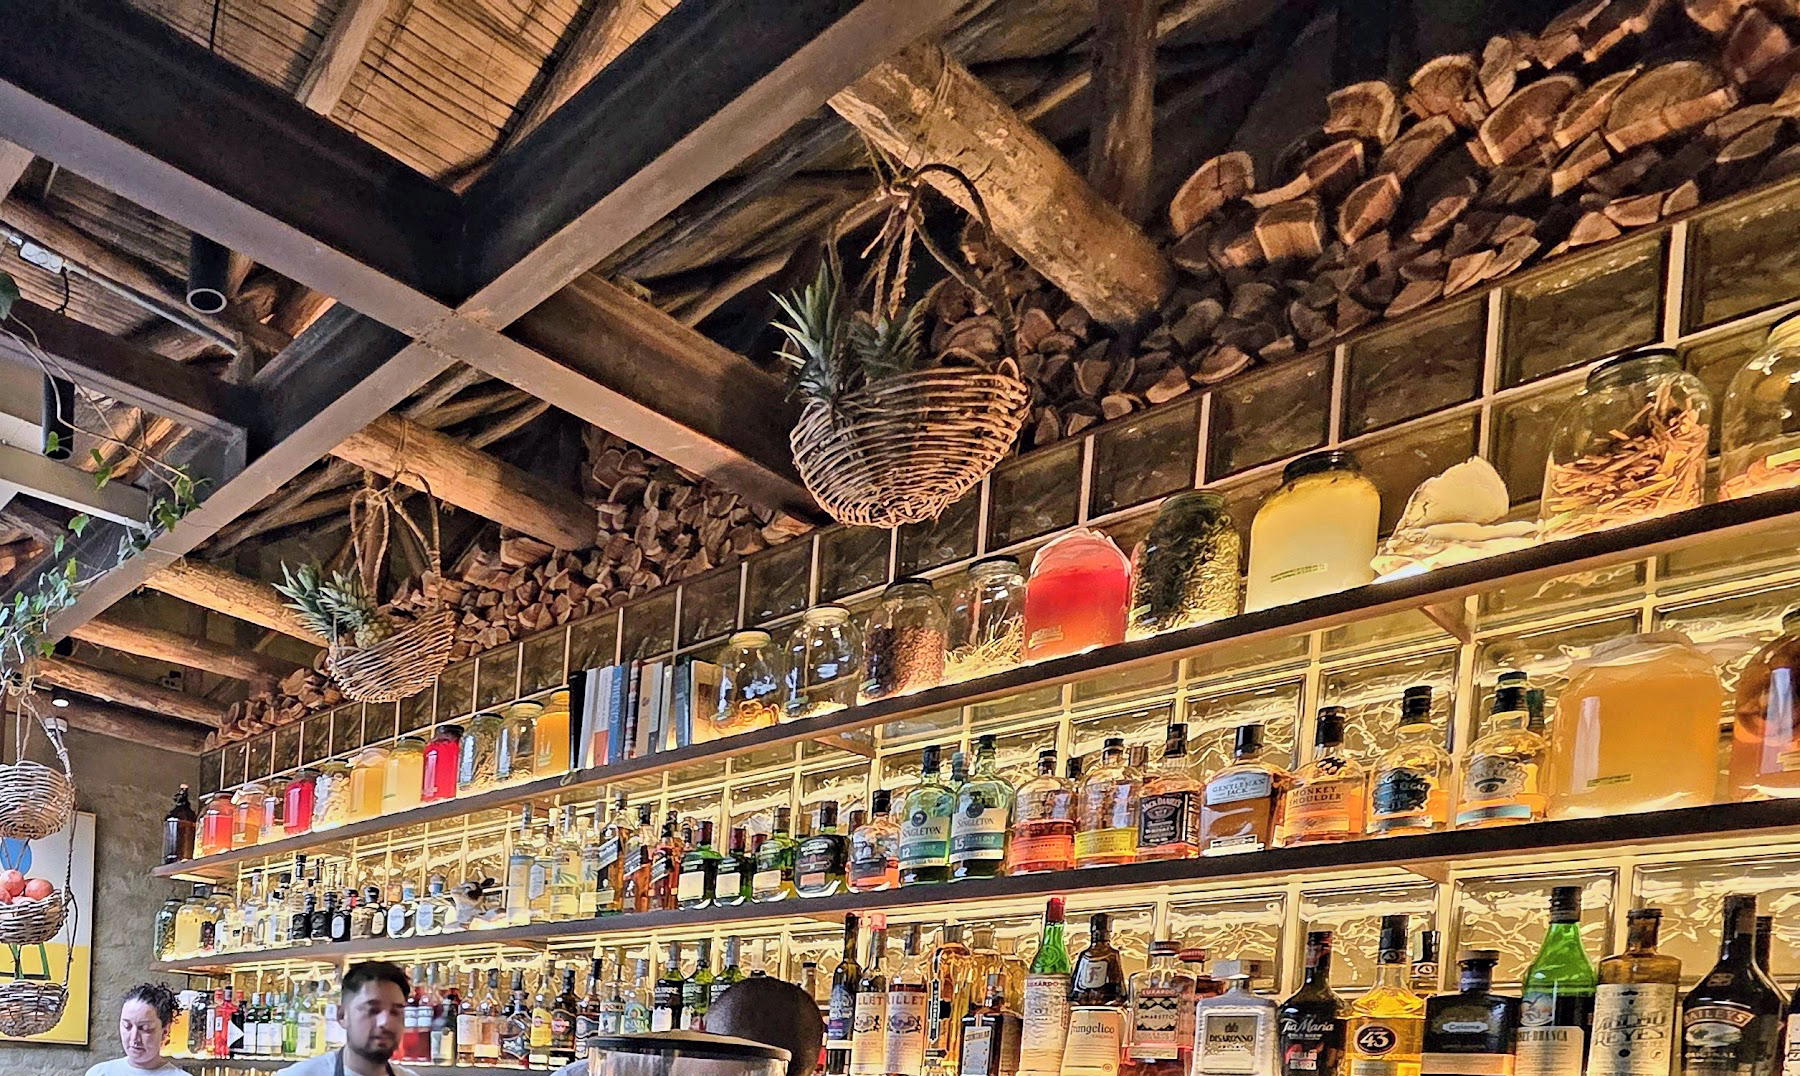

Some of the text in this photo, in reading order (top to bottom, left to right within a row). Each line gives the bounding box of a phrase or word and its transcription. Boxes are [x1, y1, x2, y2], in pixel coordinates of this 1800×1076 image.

[1211, 779, 1266, 793] GENTLEMAN
[1292, 786, 1337, 798] MONKEY
[1289, 793, 1342, 806] SHOULDER
[954, 839, 965, 850] 15
[902, 848, 911, 858] 12
[1141, 988, 1176, 997] LUXARDO
[1296, 1018, 1335, 1033] Maria
[1209, 1033, 1254, 1044] DISARONNO
[1360, 1031, 1390, 1049] 43
